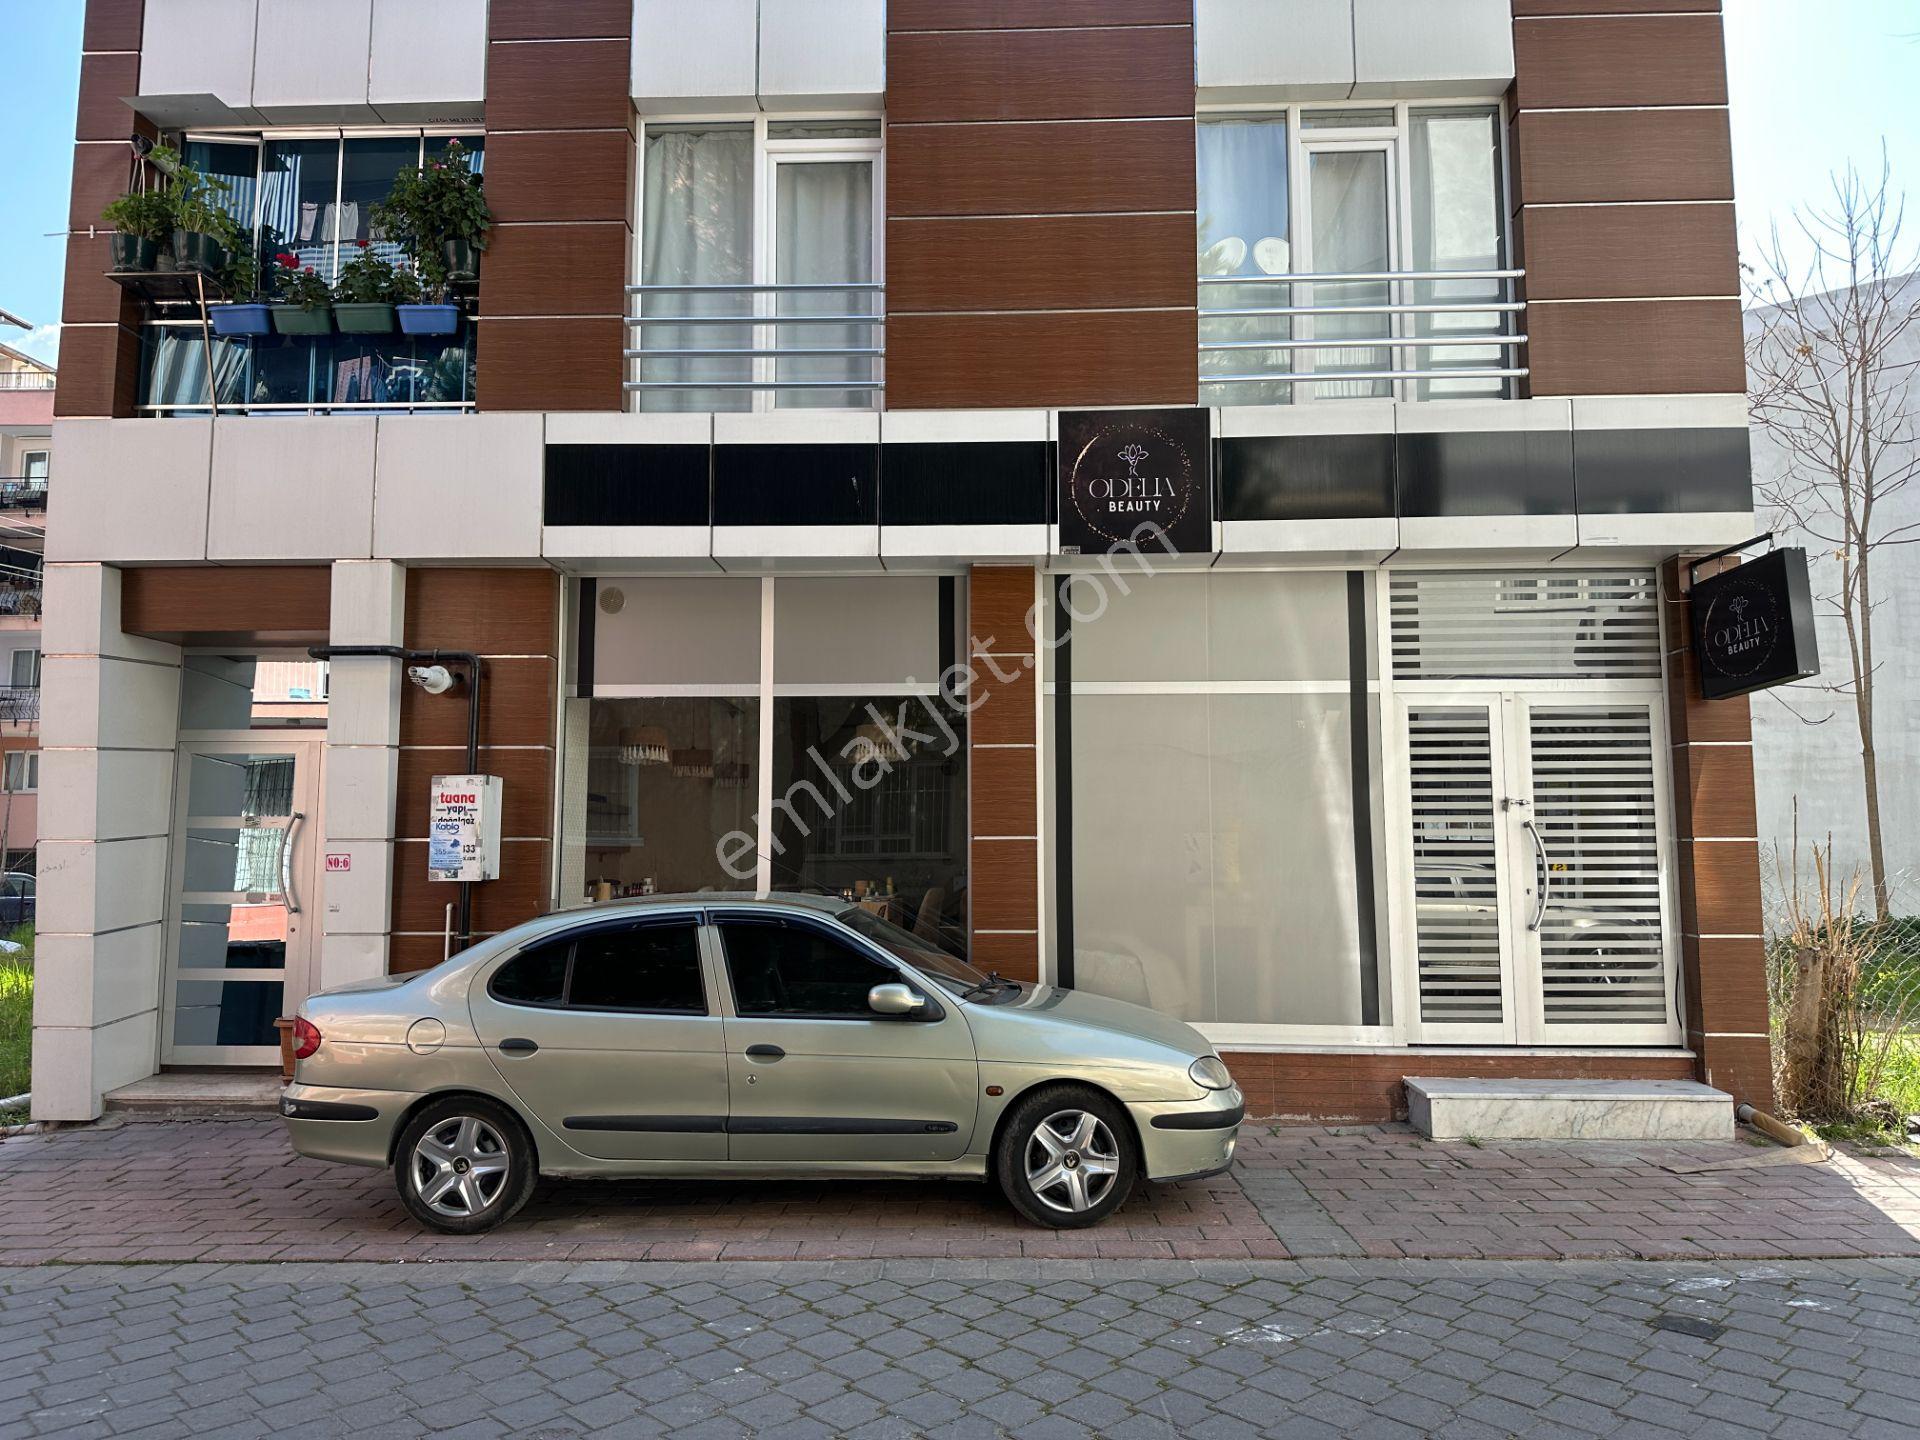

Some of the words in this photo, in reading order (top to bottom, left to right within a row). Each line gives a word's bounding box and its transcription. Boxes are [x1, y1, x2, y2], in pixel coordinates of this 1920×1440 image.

[1089, 477, 1176, 499] ODELIA
[1108, 501, 1161, 512] BEAUTY
[1727, 636, 1760, 655] BEAUTY
[440, 792, 476, 804] tuana
[327, 857, 349, 868] NO:6
